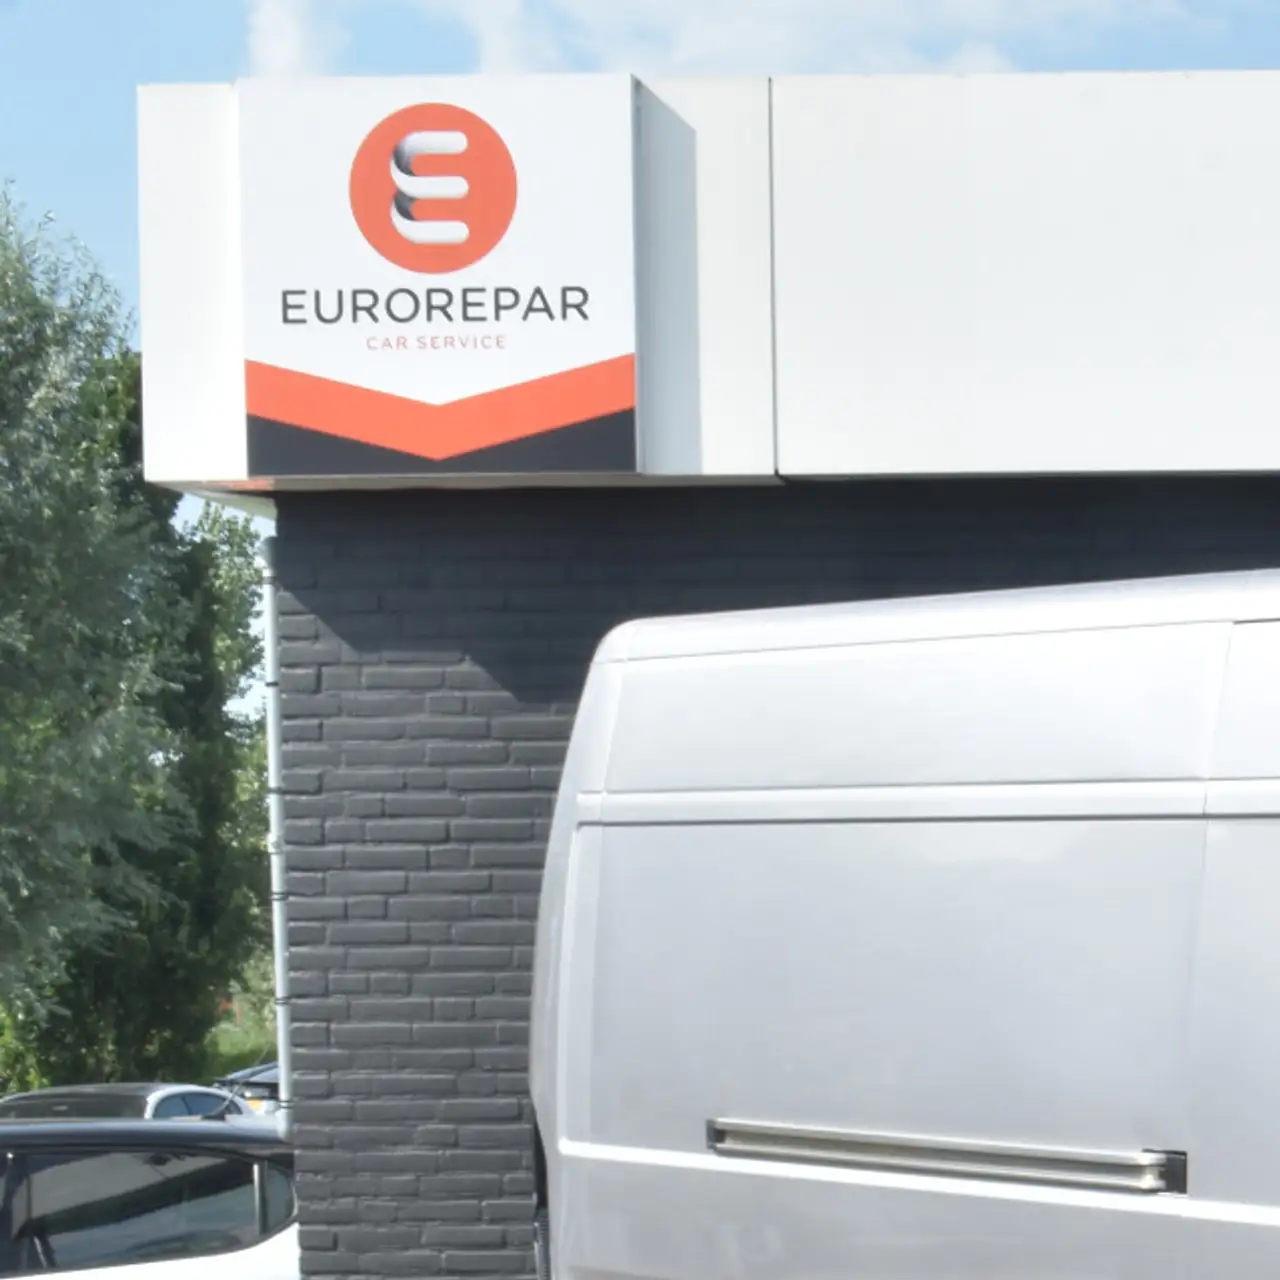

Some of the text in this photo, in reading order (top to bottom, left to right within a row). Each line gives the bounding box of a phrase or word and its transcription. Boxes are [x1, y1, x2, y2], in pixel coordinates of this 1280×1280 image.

[281, 285, 590, 325] EUROREPAR
[366, 334, 507, 351] CAR SERVICE
